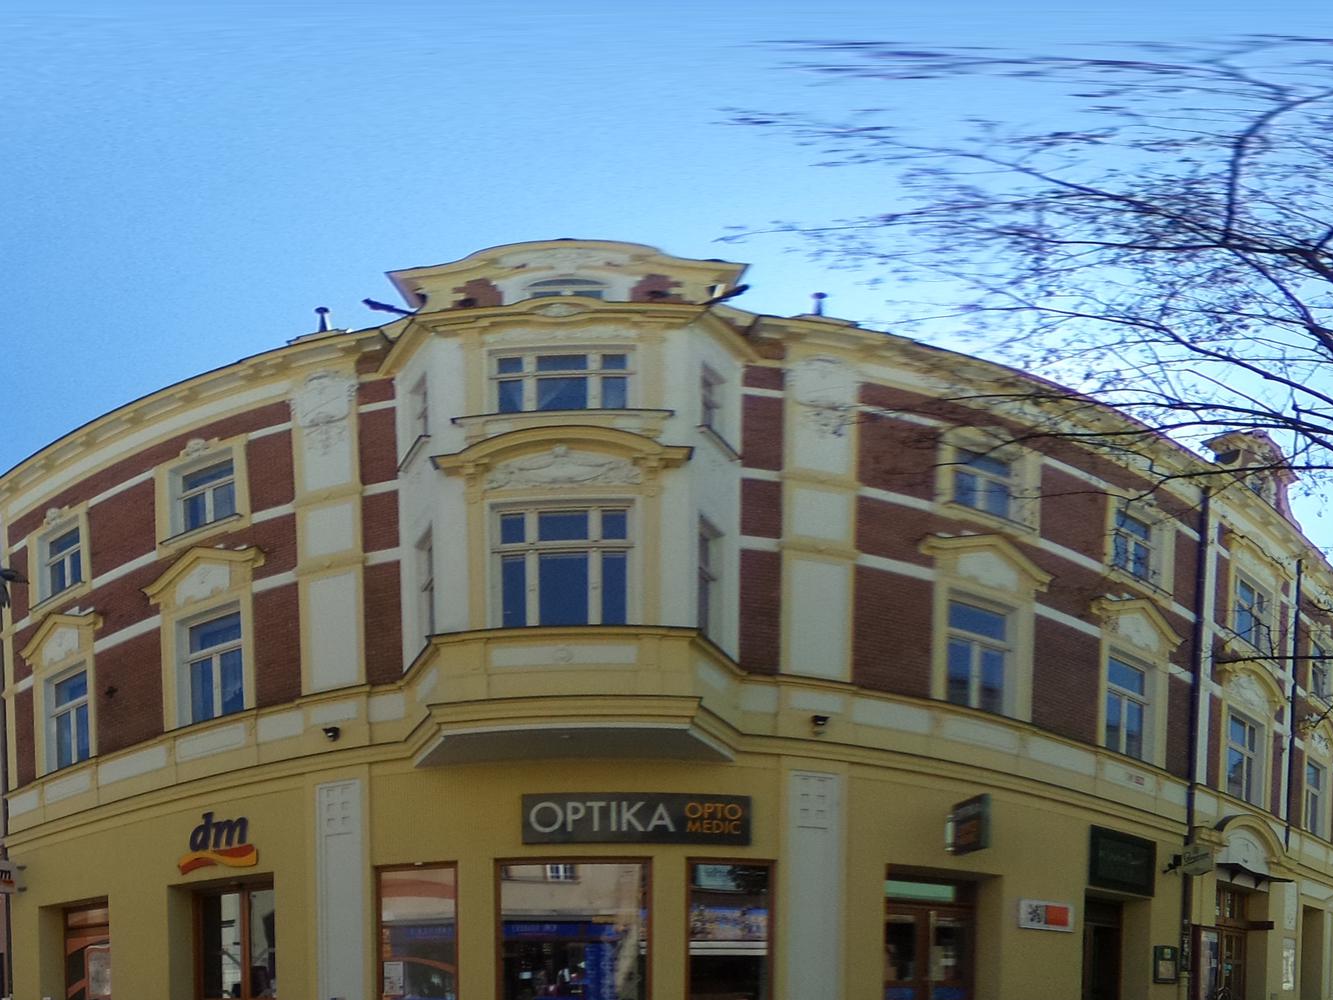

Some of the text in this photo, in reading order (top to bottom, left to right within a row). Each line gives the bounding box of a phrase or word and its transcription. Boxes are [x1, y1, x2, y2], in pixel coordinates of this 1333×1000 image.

[529, 801, 676, 833] OPTIKA
[684, 802, 743, 819] OPTO
[189, 811, 249, 852] dm
[687, 820, 741, 833] MEDIC
